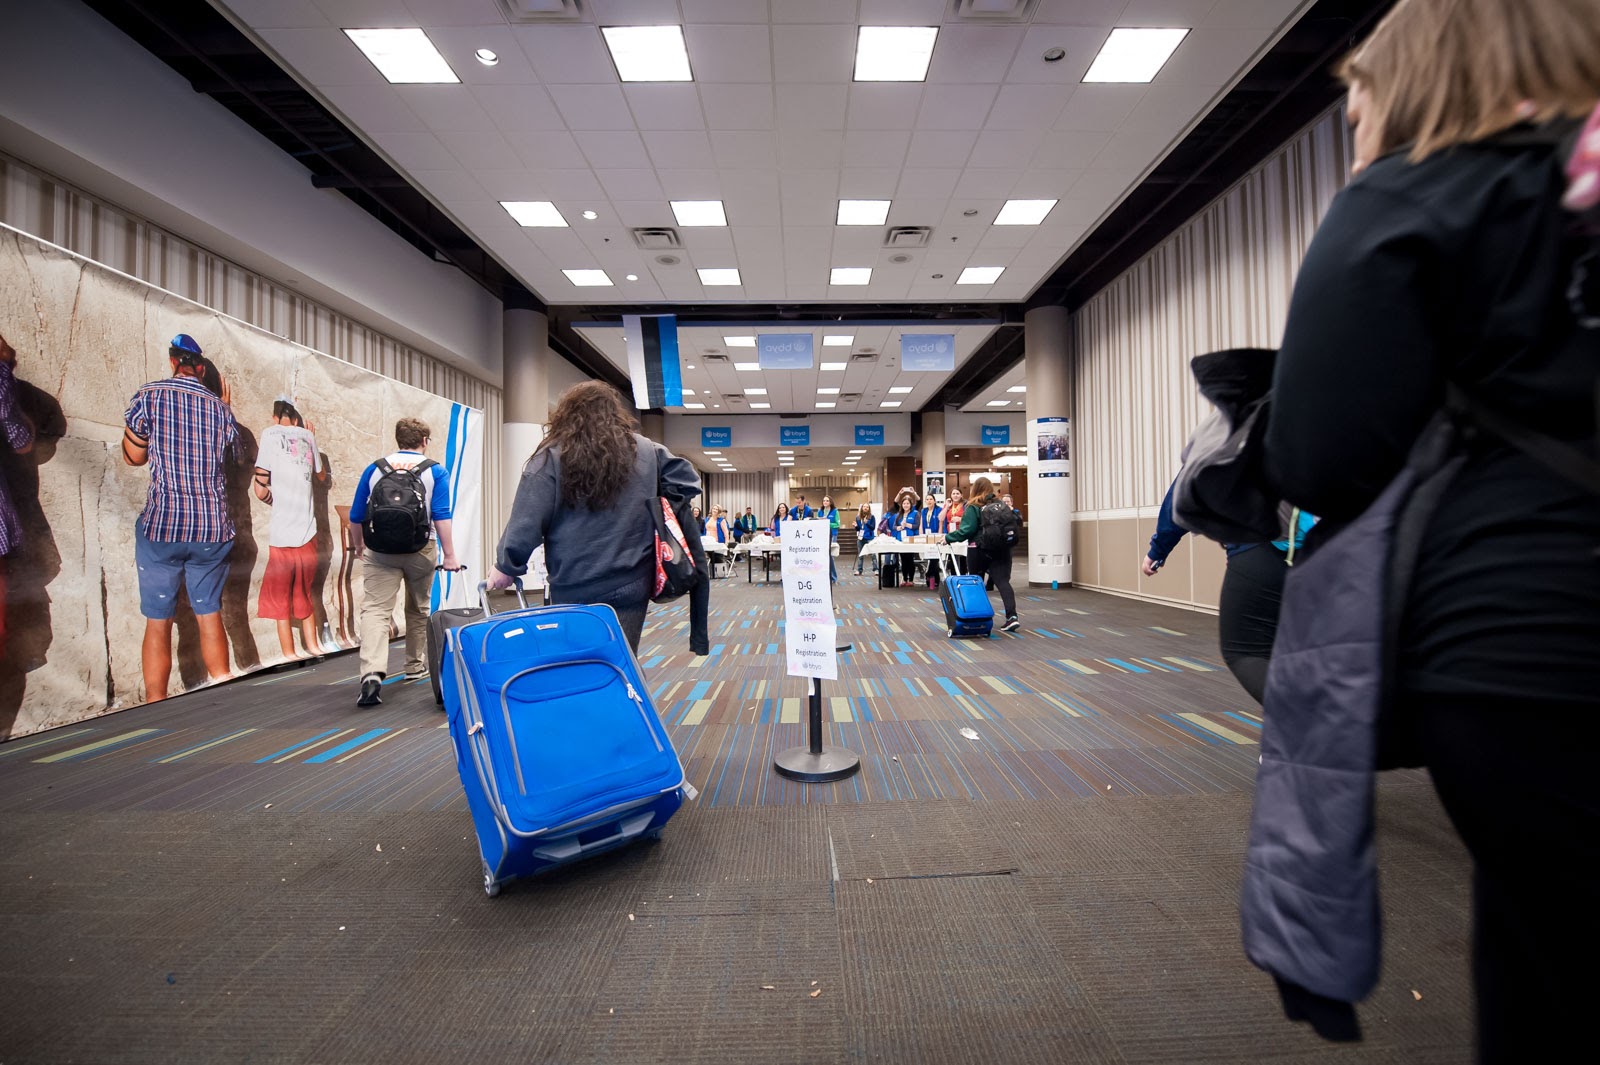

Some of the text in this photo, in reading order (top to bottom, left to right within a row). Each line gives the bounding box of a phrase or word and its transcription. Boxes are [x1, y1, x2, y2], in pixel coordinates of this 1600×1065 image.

[795, 529, 801, 539] A
[807, 529, 813, 539] C
[788, 545, 820, 554] Registration
[798, 580, 813, 590] D-G
[792, 597, 823, 605] Registration
[803, 633, 817, 642] H-P
[795, 648, 827, 657] Registration
